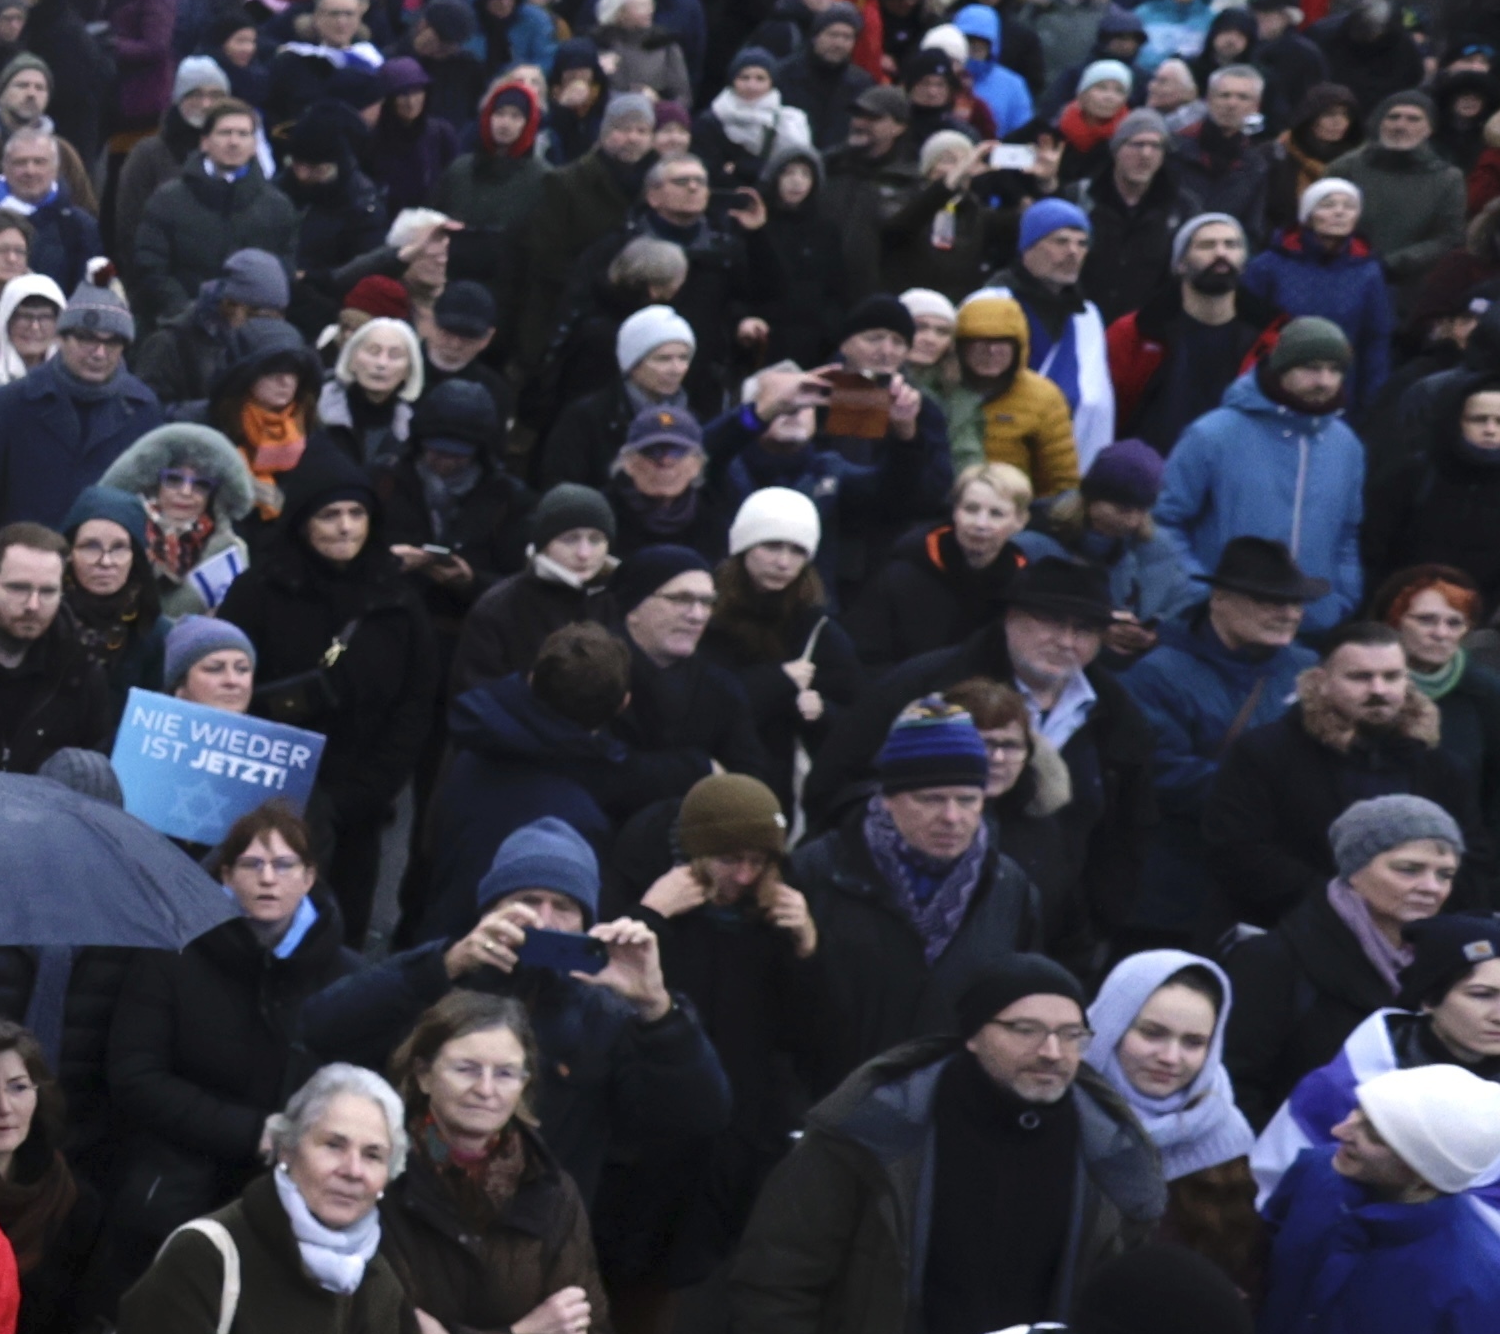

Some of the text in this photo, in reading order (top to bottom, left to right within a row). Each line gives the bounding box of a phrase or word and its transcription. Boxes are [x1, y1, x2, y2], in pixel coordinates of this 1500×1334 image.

[131, 706, 311, 769] NIE WIEDER
[141, 735, 288, 790] IST JETZT!
